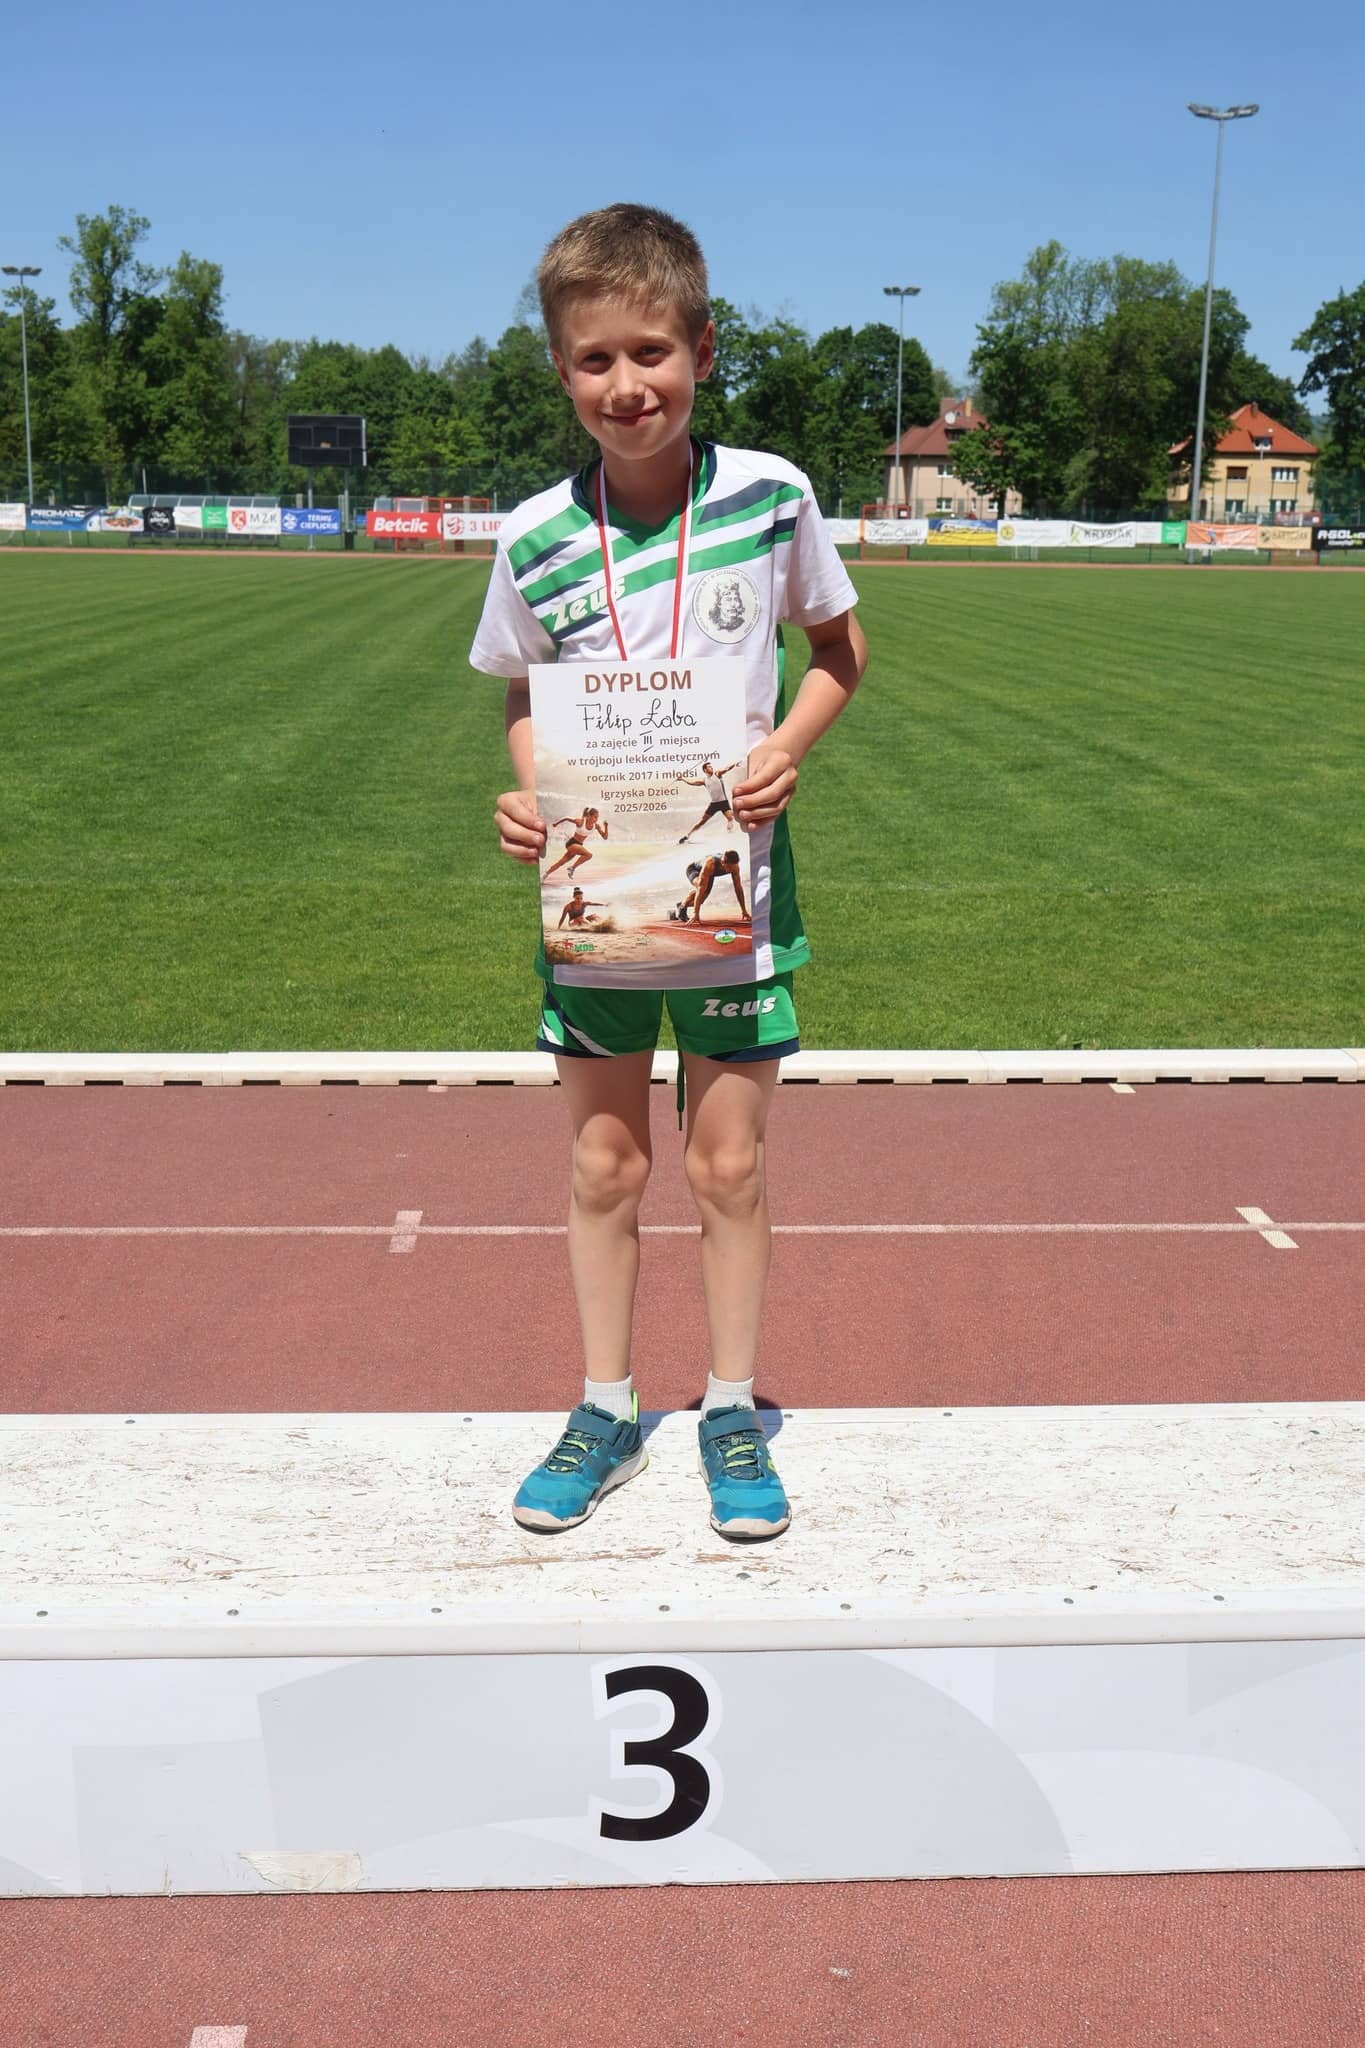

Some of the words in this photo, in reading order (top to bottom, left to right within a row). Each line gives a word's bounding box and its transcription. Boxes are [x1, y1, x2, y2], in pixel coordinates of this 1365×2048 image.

[374, 517, 428, 533] Betclic
[469, 520, 477, 532] 3
[551, 577, 626, 633] Zeus
[584, 670, 692, 694] DYPLOM
[576, 703, 632, 735] Filip
[586, 740, 598, 749] za
[600, 738, 638, 751] zajęcie
[659, 735, 700, 747] miejsca
[567, 758, 577, 766] w
[579, 755, 623, 768] trójboju
[625, 751, 721, 765] lekkoatletycznym
[586, 772, 626, 782] rocznik
[628, 771, 653, 781] 2017
[655, 770, 659, 780] i
[661, 769, 698, 780] młodsi
[600, 788, 645, 800] Igrzyska
[647, 786, 679, 797] Dzieci
[613, 801, 668, 814] 2025/2026
[701, 996, 776, 1018] Zeus
[600, 1665, 710, 1841] 3
